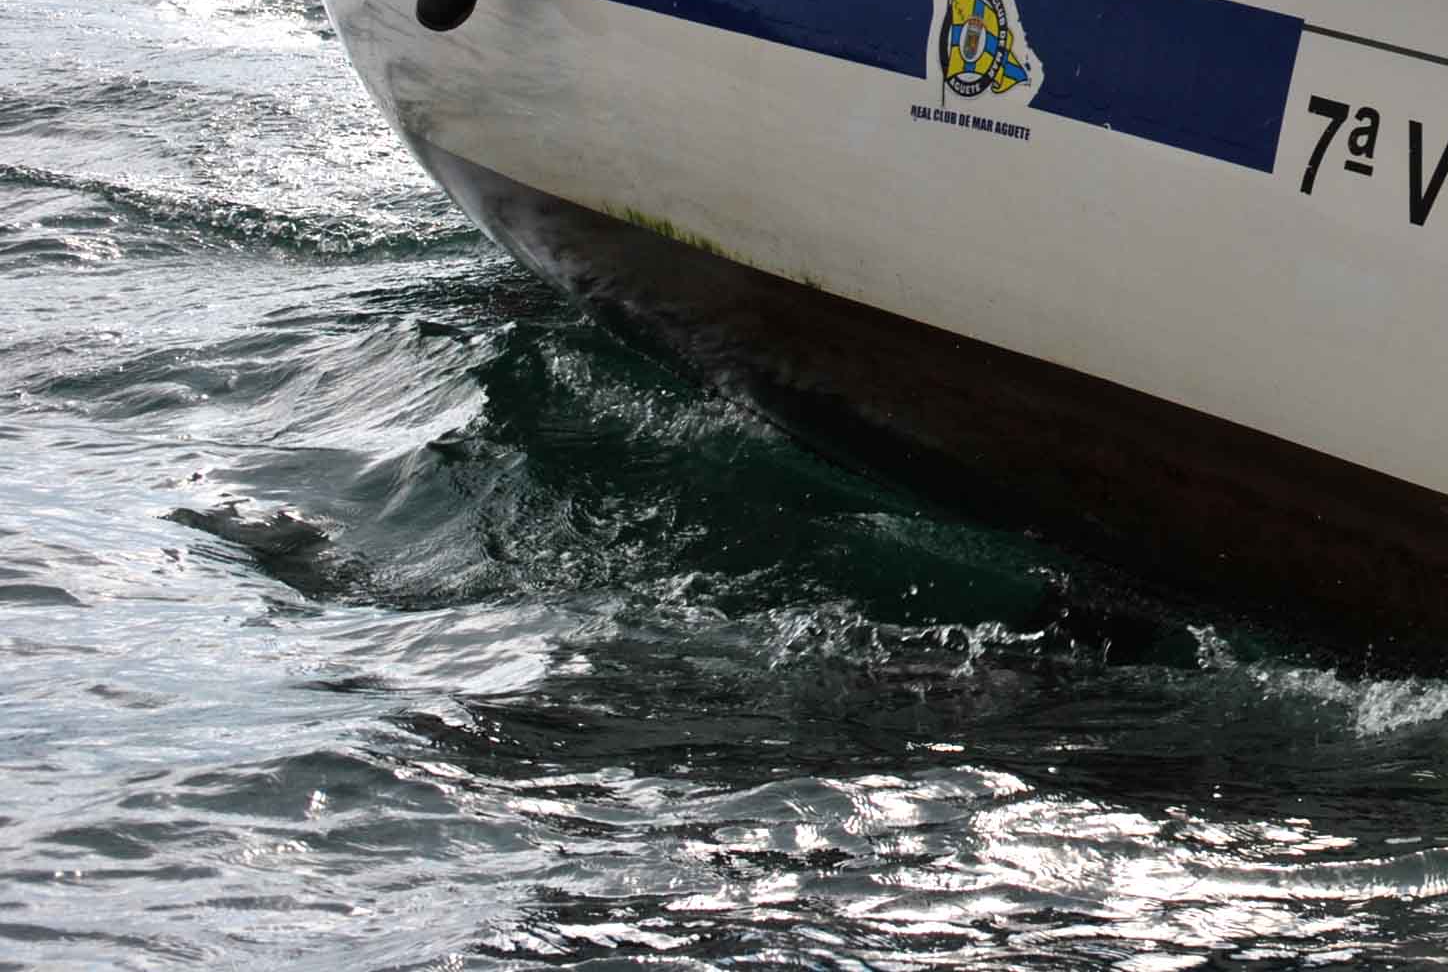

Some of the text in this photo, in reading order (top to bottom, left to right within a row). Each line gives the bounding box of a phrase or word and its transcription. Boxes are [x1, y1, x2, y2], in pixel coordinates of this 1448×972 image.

[949, 77, 981, 96] AGUETE
[910, 105, 1031, 140] REAL CLUB DE MAR AGUETE
